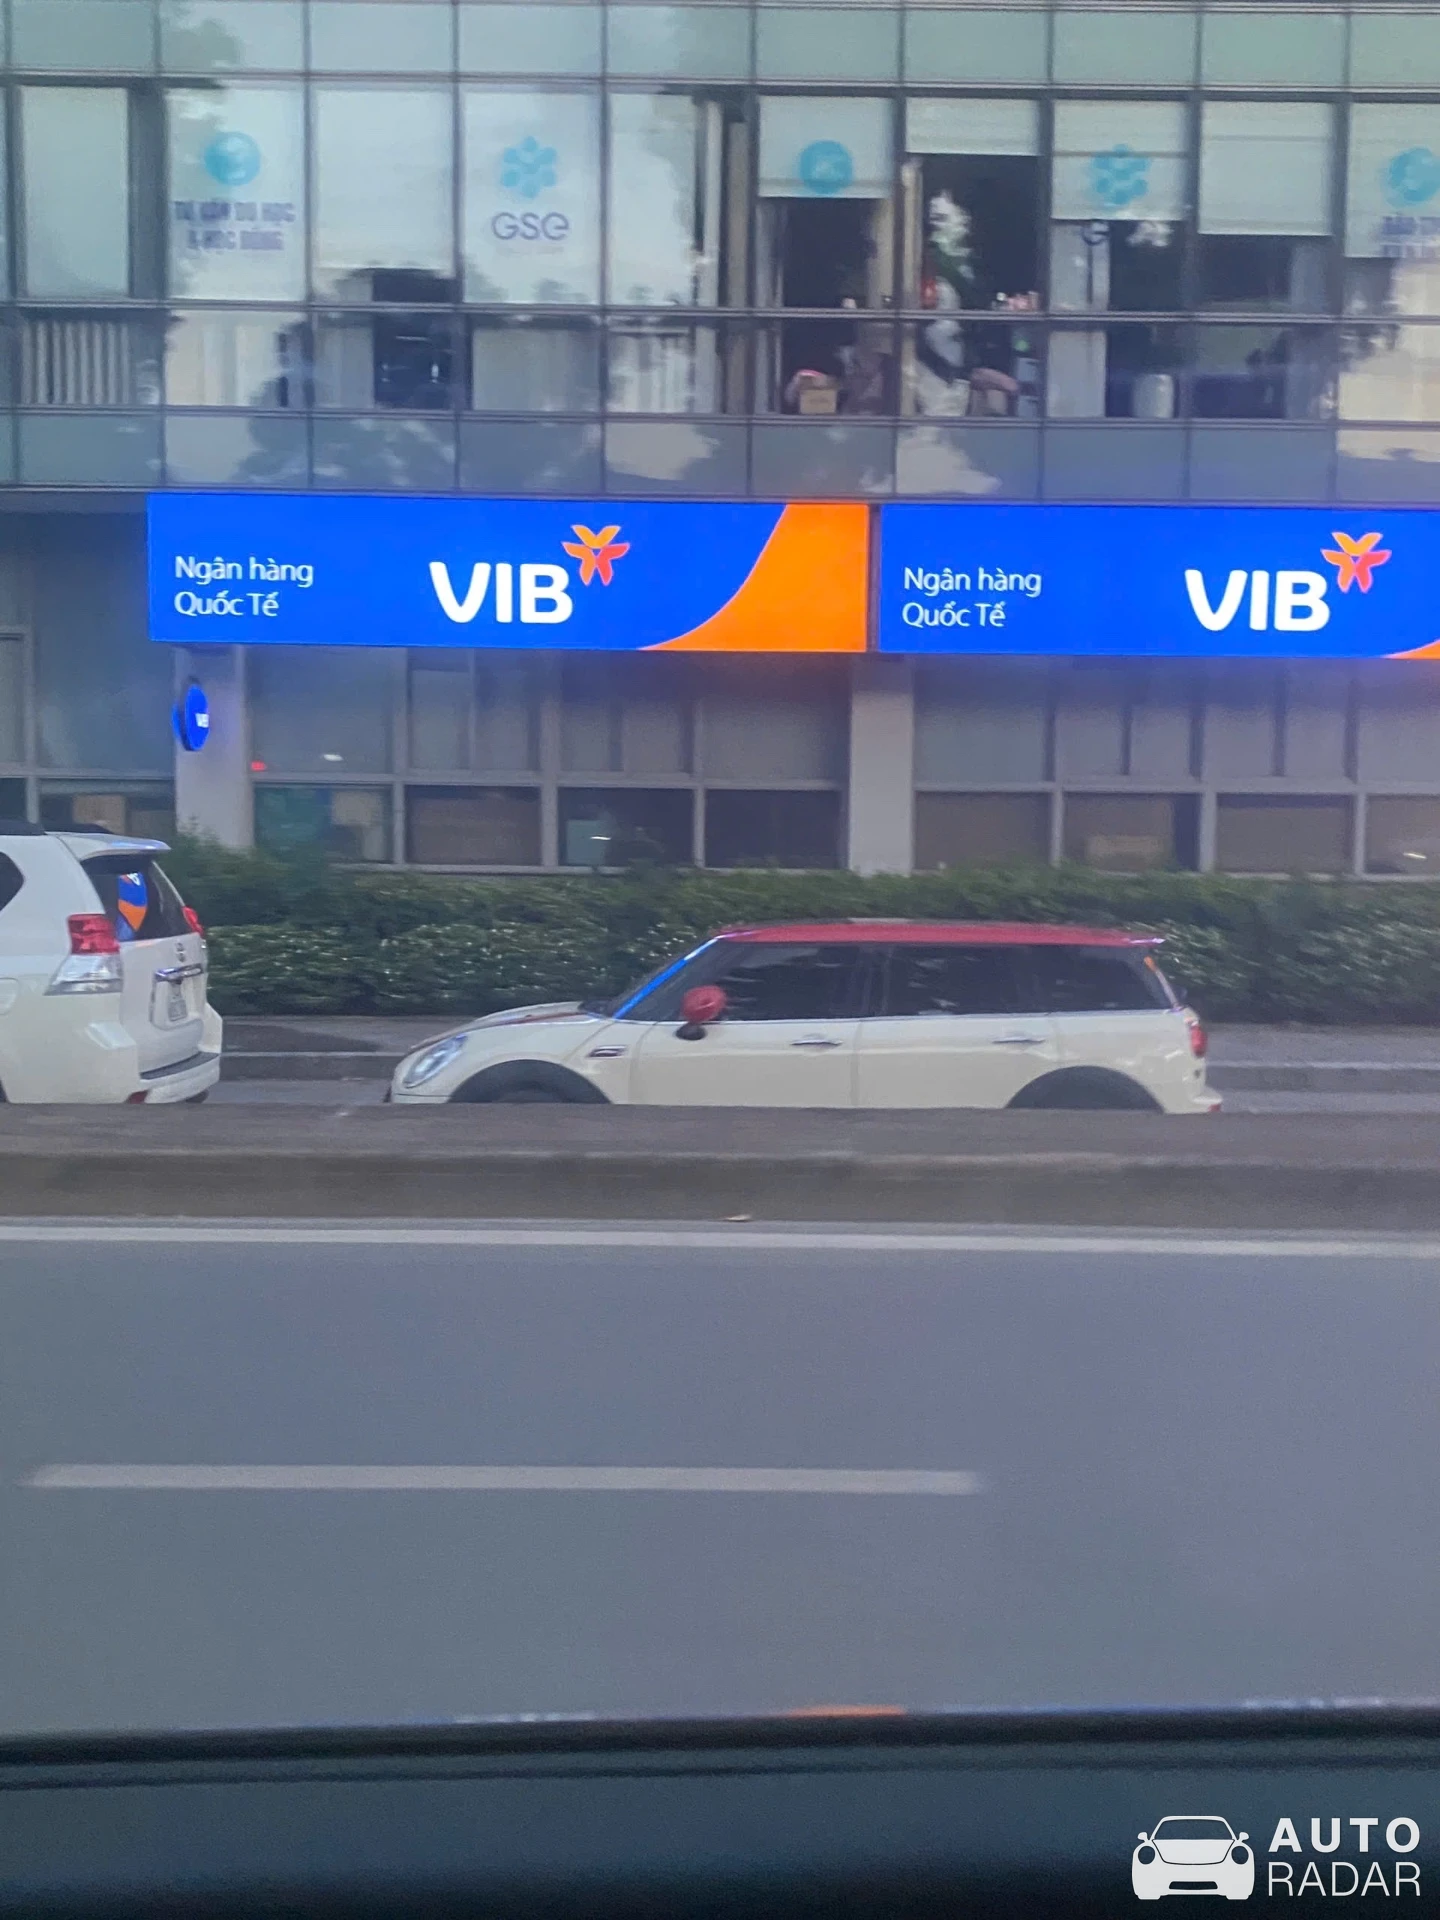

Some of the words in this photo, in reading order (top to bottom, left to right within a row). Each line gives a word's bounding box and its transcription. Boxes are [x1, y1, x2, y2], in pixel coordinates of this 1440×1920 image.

[176, 556, 242, 587] Ngân
[249, 557, 313, 590] hàng
[904, 568, 970, 596] Ngân
[978, 567, 1041, 598] hàng
[174, 591, 243, 616] Quốc
[247, 592, 279, 617] Tế
[429, 561, 573, 624] VIB
[1185, 569, 1330, 631] VIB
[902, 602, 970, 627] Quốc
[976, 601, 1007, 626] Tế
